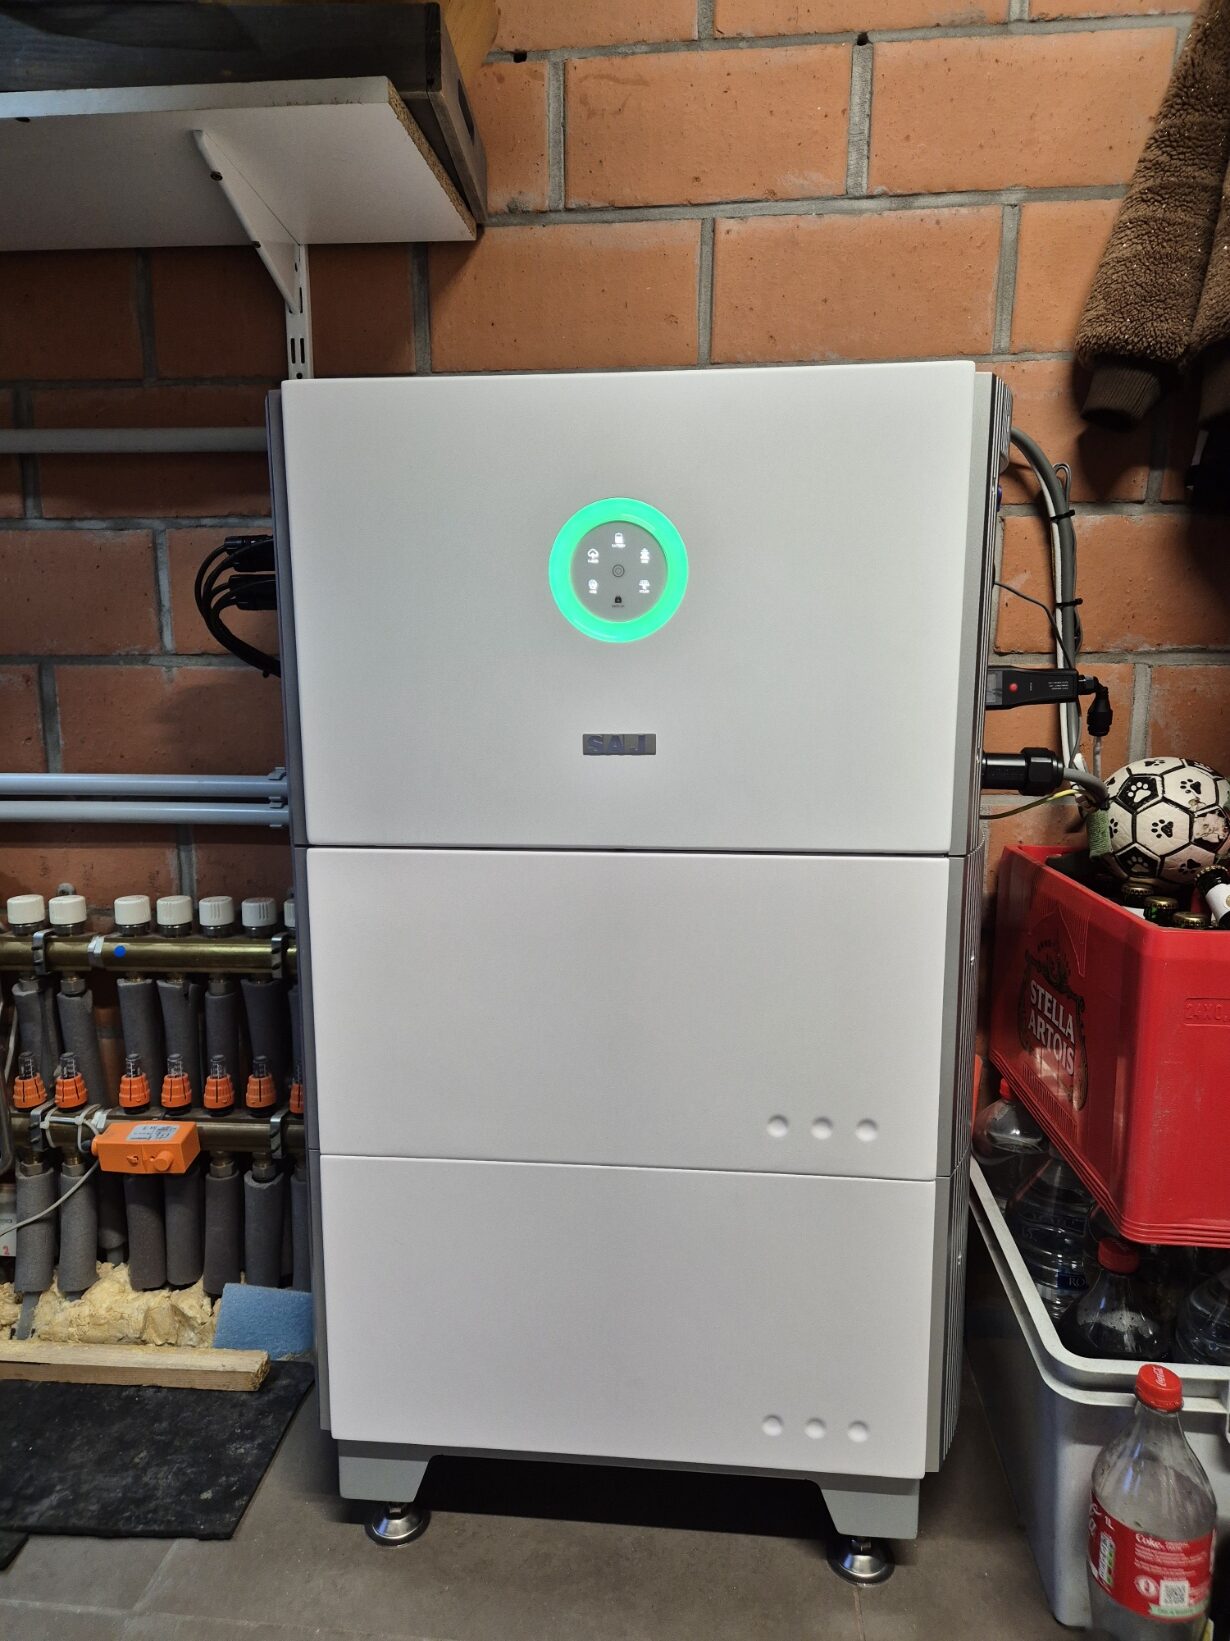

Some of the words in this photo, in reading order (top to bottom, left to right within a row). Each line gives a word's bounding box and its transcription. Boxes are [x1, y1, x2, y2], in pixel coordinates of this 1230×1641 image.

[586, 734, 646, 755] SAJ
[1030, 979, 1075, 1044] STELLA
[1185, 1003, 1230, 1022] 24X0,
[1028, 1009, 1075, 1075] ARTOIS
